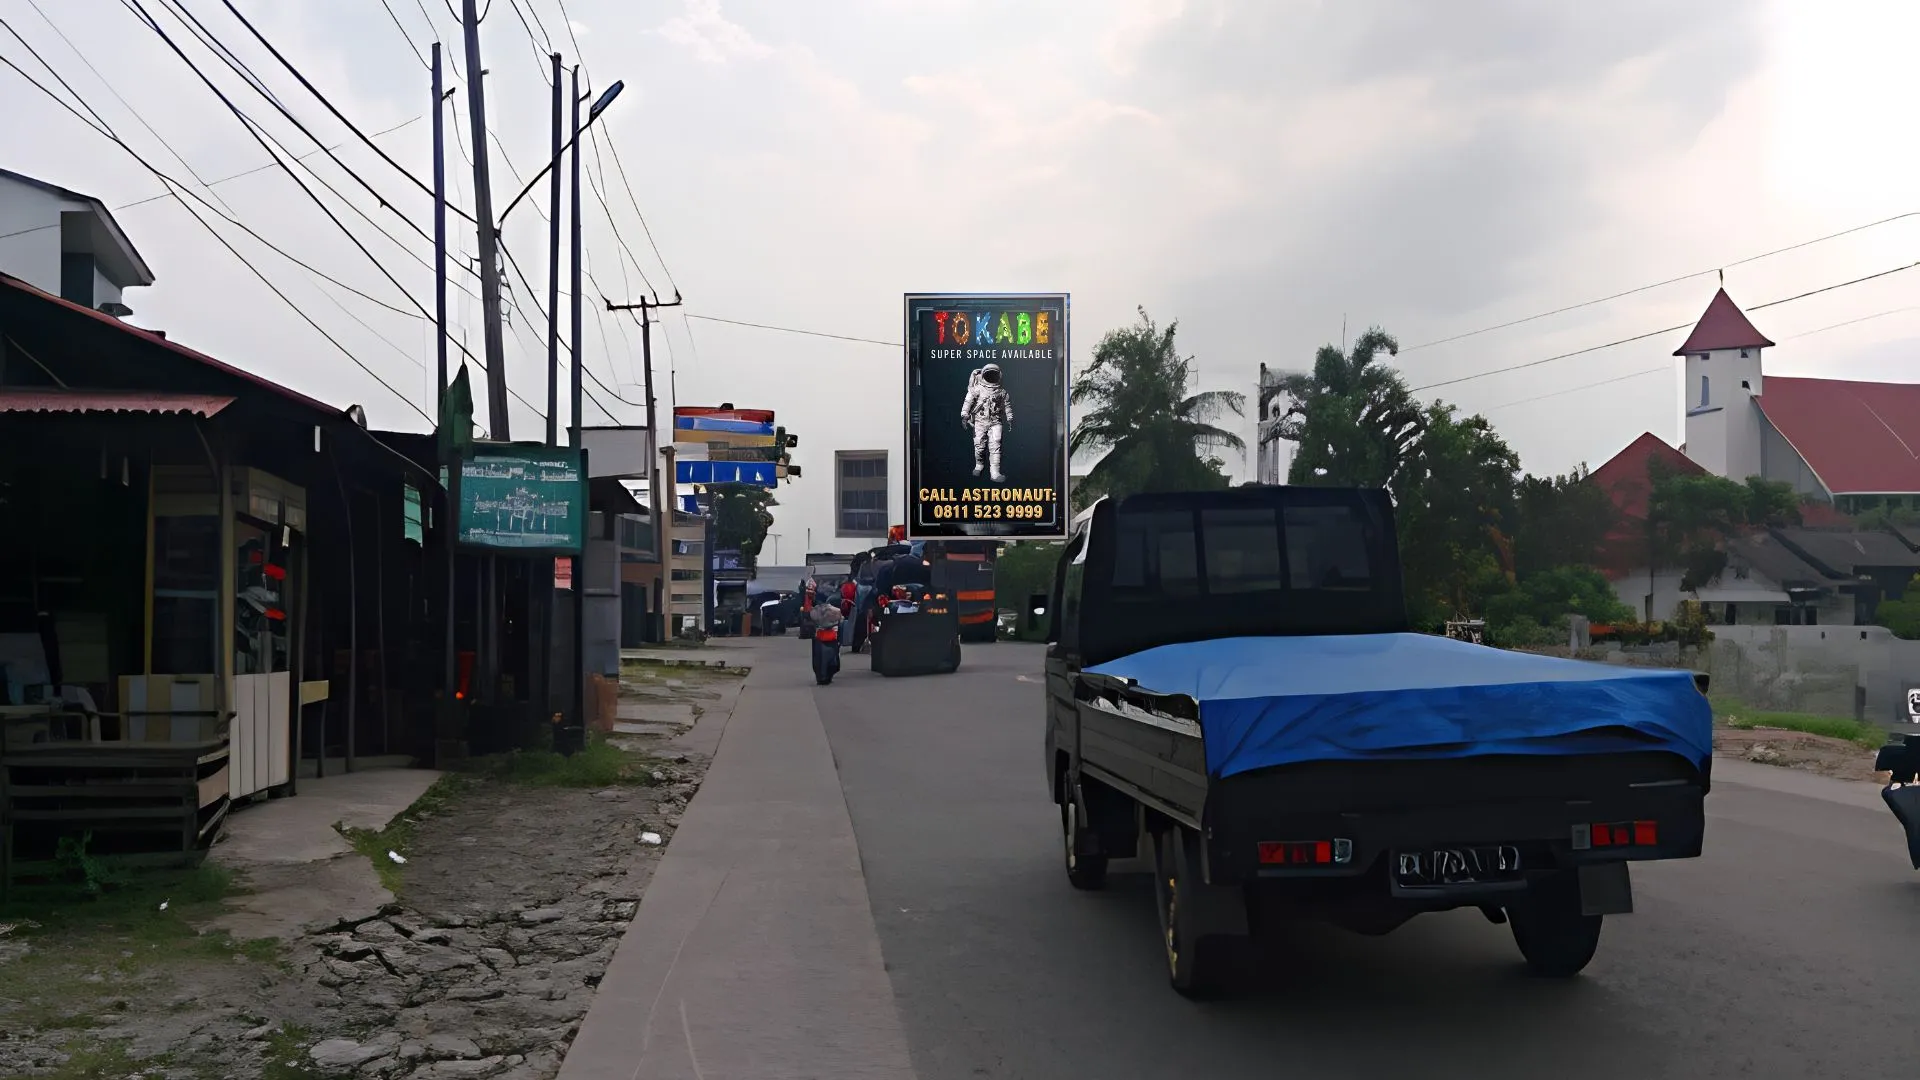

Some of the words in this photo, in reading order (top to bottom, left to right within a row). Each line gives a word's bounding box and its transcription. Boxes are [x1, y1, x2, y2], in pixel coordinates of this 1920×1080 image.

[933, 311, 1049, 346] TOKABE
[931, 349, 962, 359] SUPER
[967, 349, 997, 359] SPACE
[1001, 349, 1053, 359] AVAILABLE
[919, 488, 957, 502] CALL
[962, 488, 1057, 502] ASTRONAUT:
[934, 505, 968, 519] 0811
[974, 505, 1002, 519] 523
[1006, 505, 1043, 519] 9999
